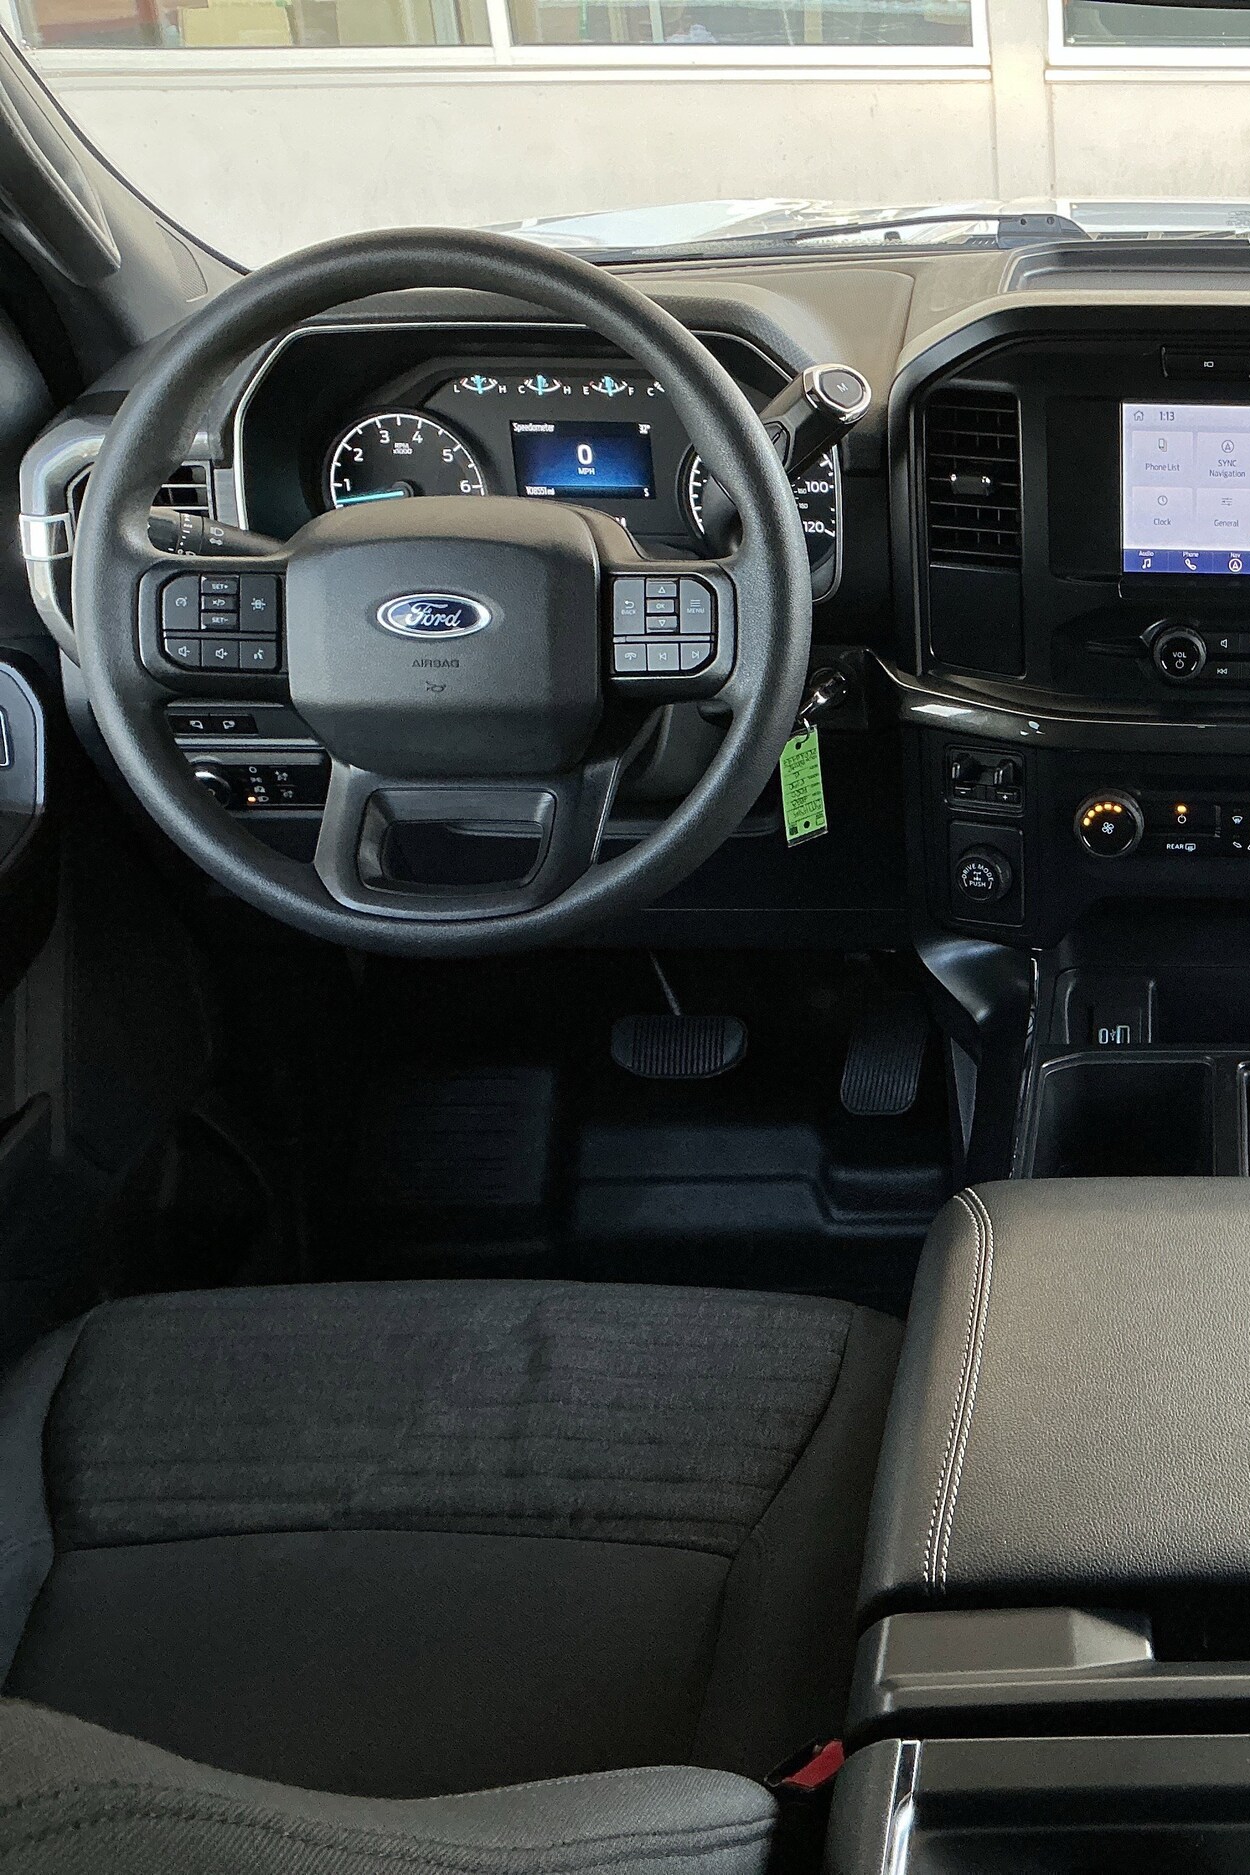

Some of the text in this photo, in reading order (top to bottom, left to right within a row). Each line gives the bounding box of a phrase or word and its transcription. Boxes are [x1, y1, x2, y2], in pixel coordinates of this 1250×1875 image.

[837, 382, 849, 393] M
[1159, 411, 1175, 421] 1:13
[379, 430, 390, 443] 3
[412, 431, 423, 444] 4
[353, 448, 364, 462] 2
[442, 449, 454, 462] 5
[577, 444, 593, 465] 0
[1145, 462, 1180, 472] Phone List
[1217, 459, 1237, 468] SYNC
[578, 467, 596, 476] MPH
[1209, 469, 1246, 479] Navigation
[343, 478, 351, 492] 1
[460, 480, 471, 493] 6
[805, 481, 829, 493] 100
[803, 521, 825, 533] 120
[1153, 518, 1171, 526] Clock
[1214, 519, 1239, 527] General
[405, 602, 462, 627] Ford
[1166, 842, 1184, 850] REAR
[961, 863, 994, 882] DRIVE MODE
